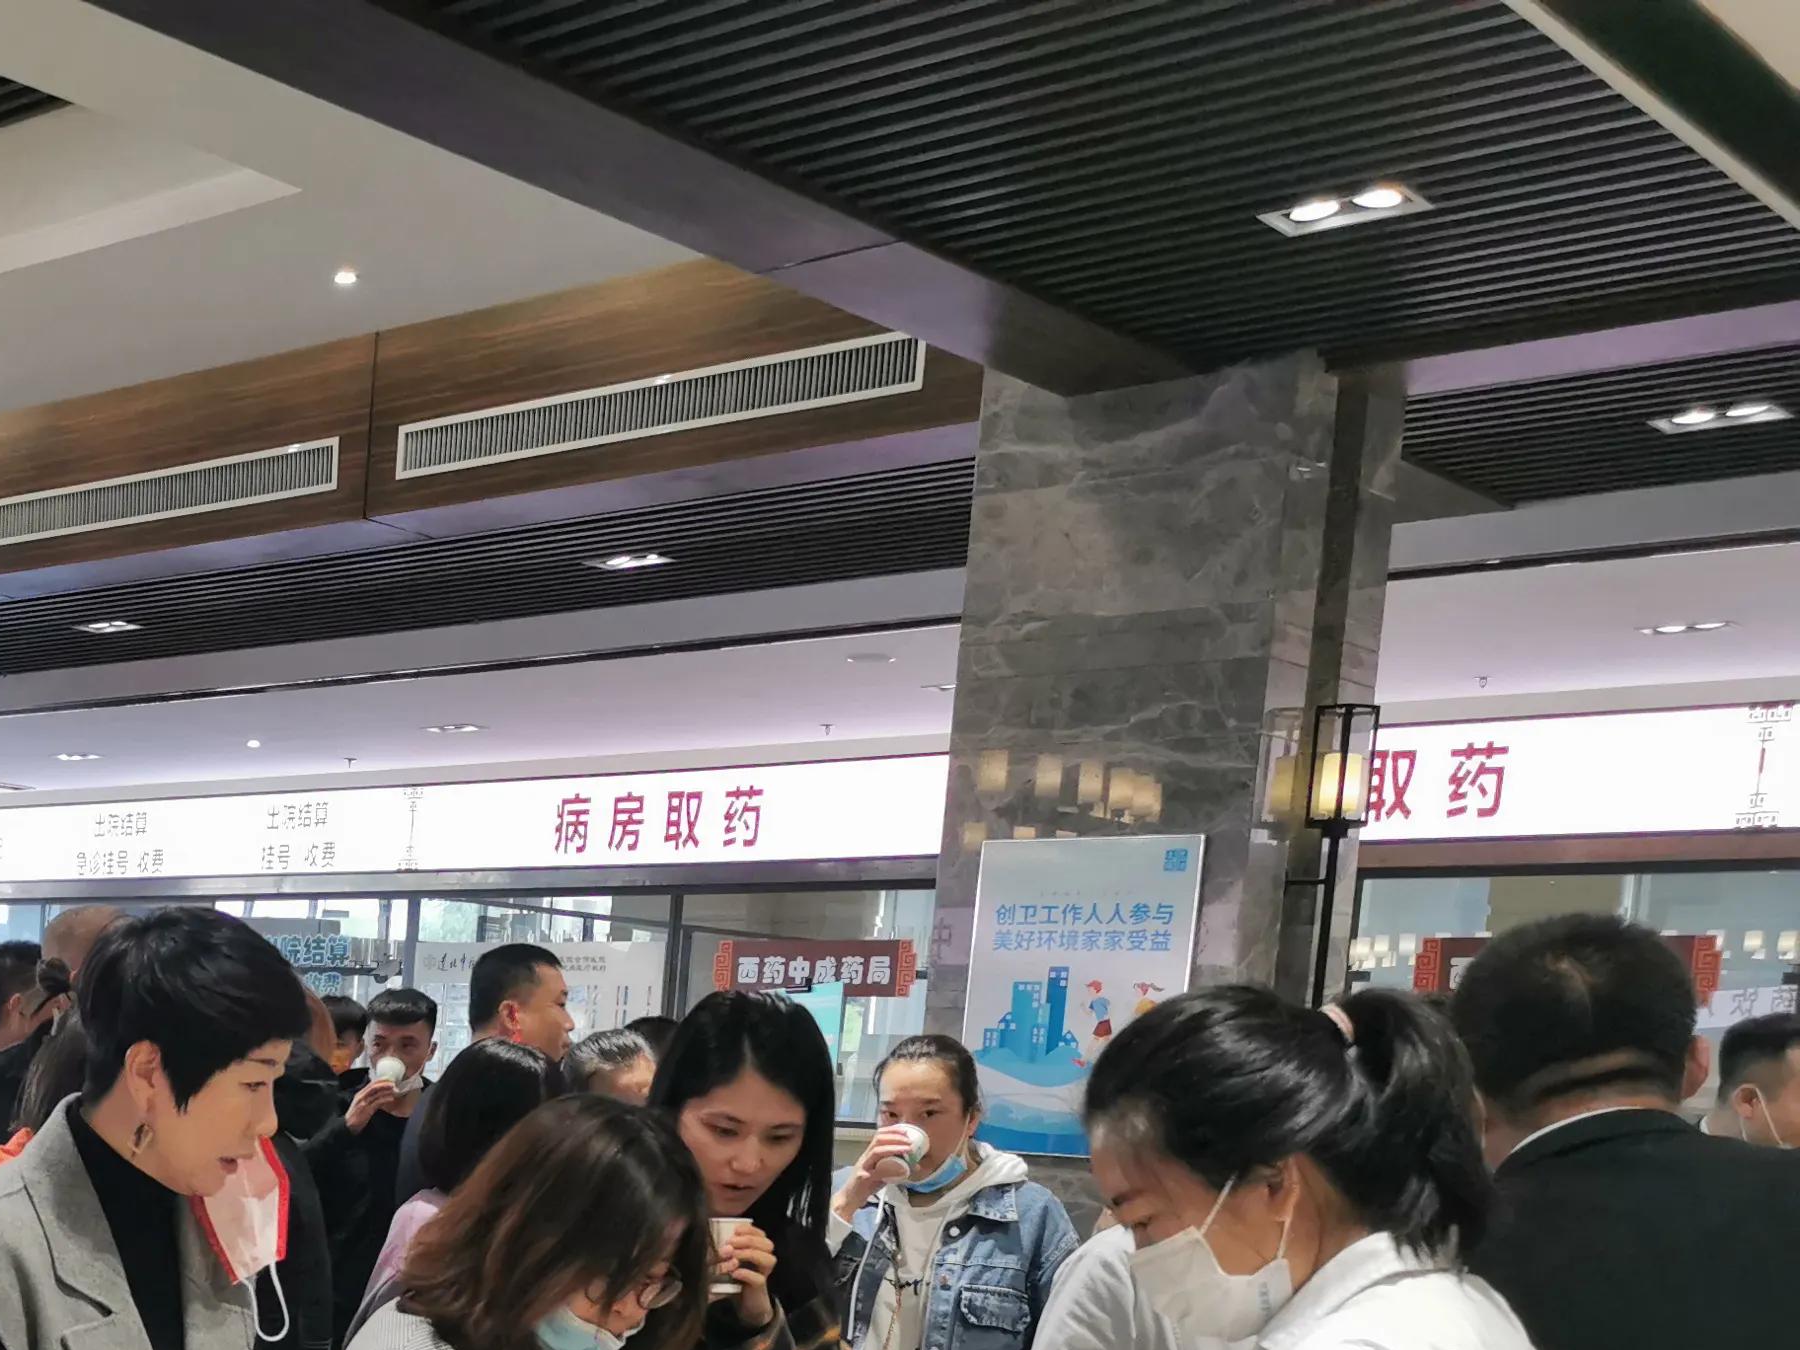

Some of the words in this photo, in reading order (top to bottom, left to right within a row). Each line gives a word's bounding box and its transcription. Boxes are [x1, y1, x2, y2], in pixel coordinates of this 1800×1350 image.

[267, 801, 329, 830] 出院结算
[554, 785, 764, 854] 病房取药
[261, 844, 291, 870] 挂号
[996, 902, 1175, 926] 创卫工作人人参与
[268, 934, 350, 967] 院结算
[992, 929, 1172, 952] 美好环境家家受益
[737, 955, 892, 985] 西药中成药局
